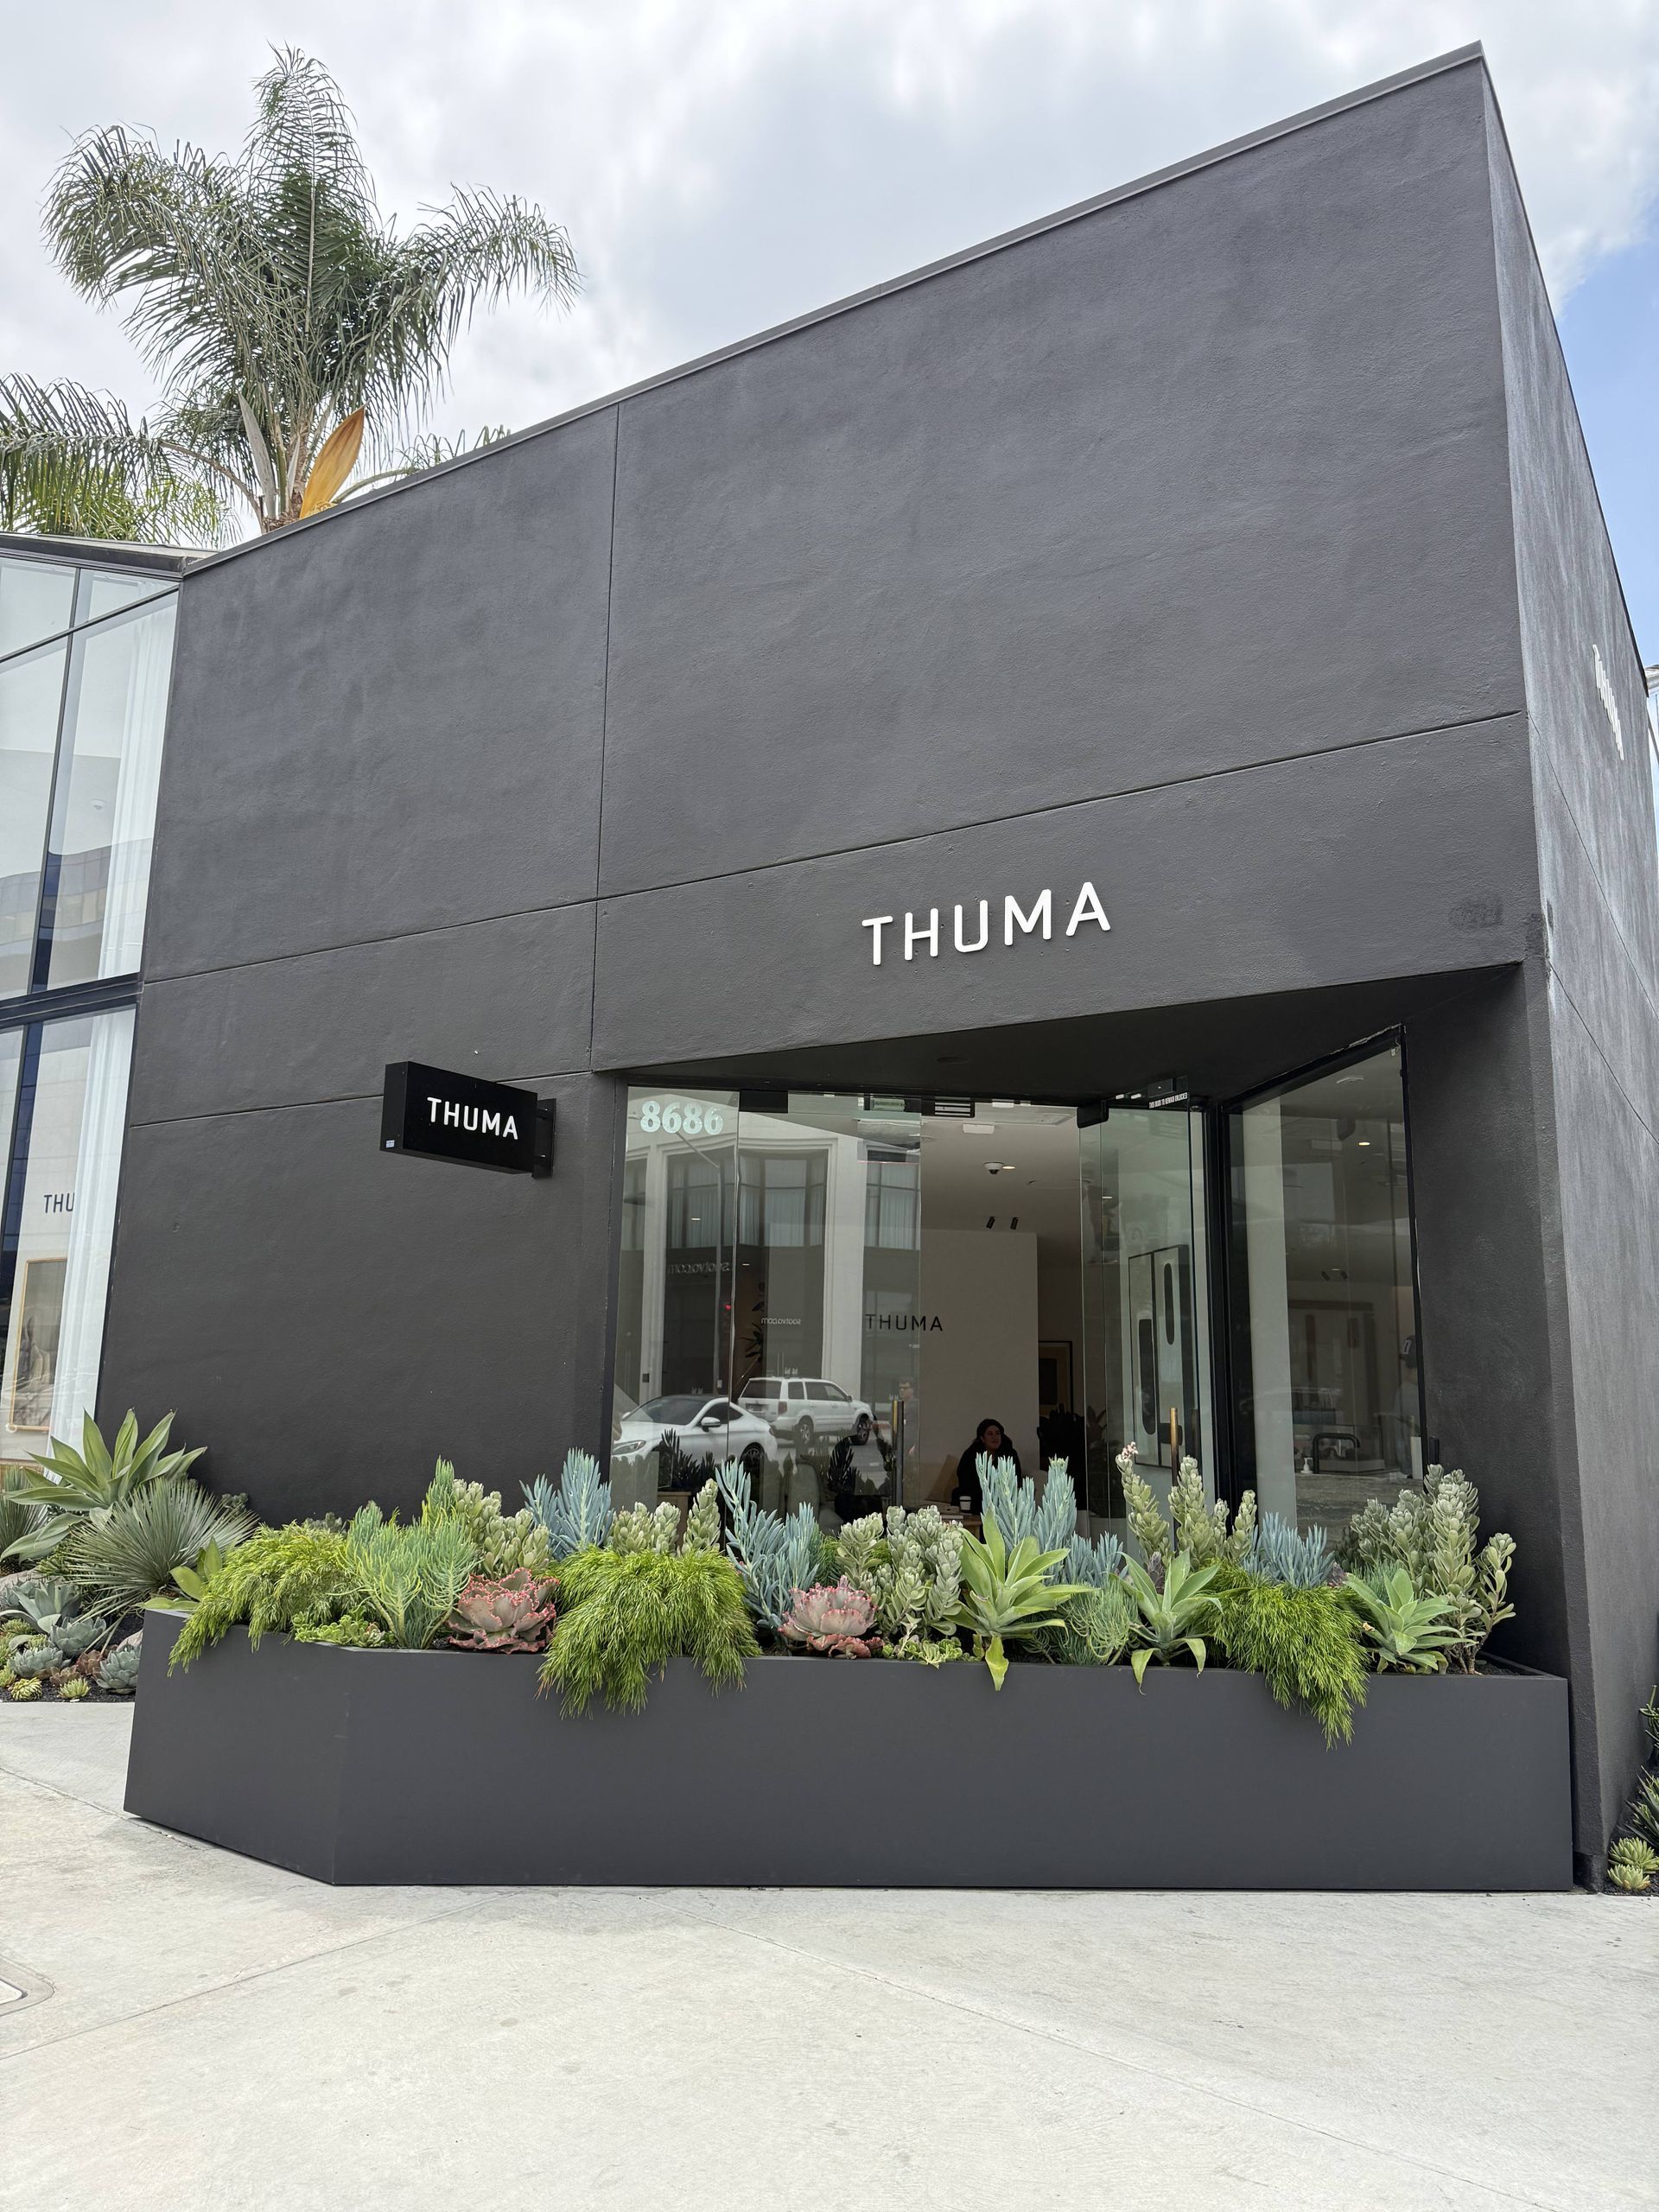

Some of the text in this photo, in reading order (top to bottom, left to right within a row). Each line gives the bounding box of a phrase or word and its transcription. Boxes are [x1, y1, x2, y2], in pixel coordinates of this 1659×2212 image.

[861, 881, 1111, 966] THUMA
[427, 1096, 518, 1141] THUMA
[640, 1100, 724, 1135] 8686
[865, 1313, 944, 1332] THUMA
